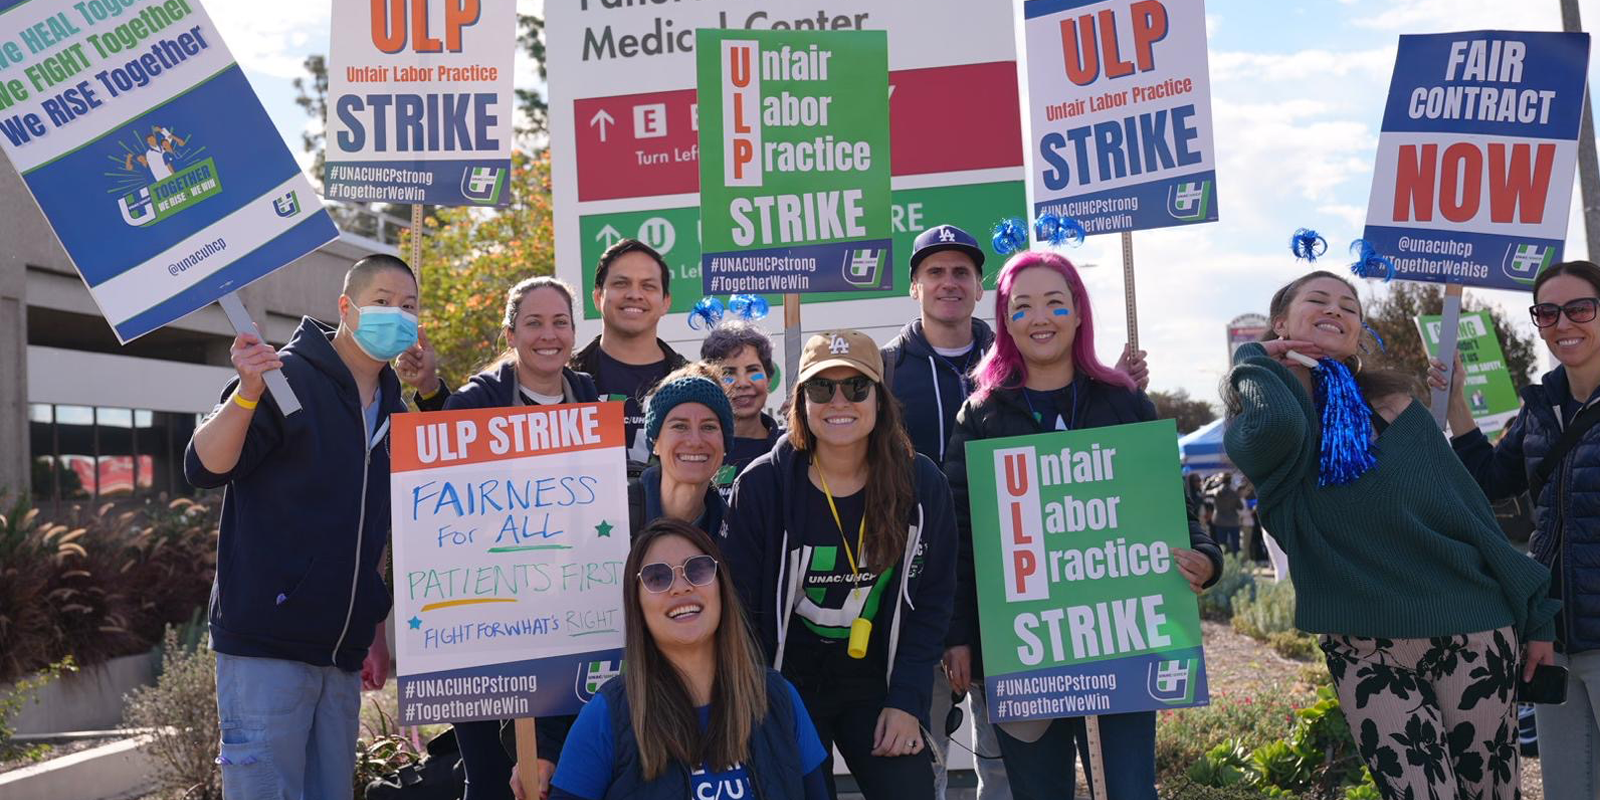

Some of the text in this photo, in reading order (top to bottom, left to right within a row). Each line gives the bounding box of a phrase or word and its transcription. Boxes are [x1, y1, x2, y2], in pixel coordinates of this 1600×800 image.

[19, 12, 81, 54] HEAL
[370, 0, 482, 54] ULP
[582, 11, 727, 61] Medicl
[1060, 0, 1169, 86] ULP
[24, 43, 91, 93] FIGHT
[346, 65, 498, 82] Unfair Labor Practice
[1445, 40, 1527, 83] FAIR
[0, 25, 208, 147] We RISE Together
[1046, 77, 1193, 122] Unfair Labor Practice
[336, 93, 499, 153] STRIKE
[643, 109, 657, 133] E
[1408, 86, 1555, 125] CONTRACT
[635, 145, 700, 165] Turn Lef
[1039, 104, 1202, 192] STRIKE
[155, 163, 211, 200] TOGETHER
[330, 166, 433, 185] #UNACUHCPstrong
[330, 183, 425, 200] #TogetherWeWin
[1392, 142, 1556, 225] NOW
[730, 189, 866, 247] STRIKE
[891, 203, 924, 233] RE
[939, 226, 955, 242] LA
[168, 238, 227, 276] @unacuhcp
[711, 256, 816, 274] #UNACUHCPstrong
[1398, 236, 1473, 258] @unacuhcp
[681, 261, 703, 279] Lef
[711, 275, 809, 292] #TogetherWeWin
[829, 334, 849, 354] LA
[416, 406, 601, 464] ULP STRIKE
[412, 476, 598, 521] FAIRNESS
[496, 513, 564, 544] ALL
[408, 561, 624, 600] PATIENTS FIRST
[424, 623, 474, 649] FIGHT
[566, 609, 619, 630] RIGHT
[1014, 594, 1172, 667] STRIKE
[405, 675, 537, 699] #UNACUHCPstrong
[996, 673, 1117, 698] #UNACUHCPstrong
[405, 697, 529, 722] #TogetherWeWin
[998, 695, 1110, 718] #TogetherWeWin
